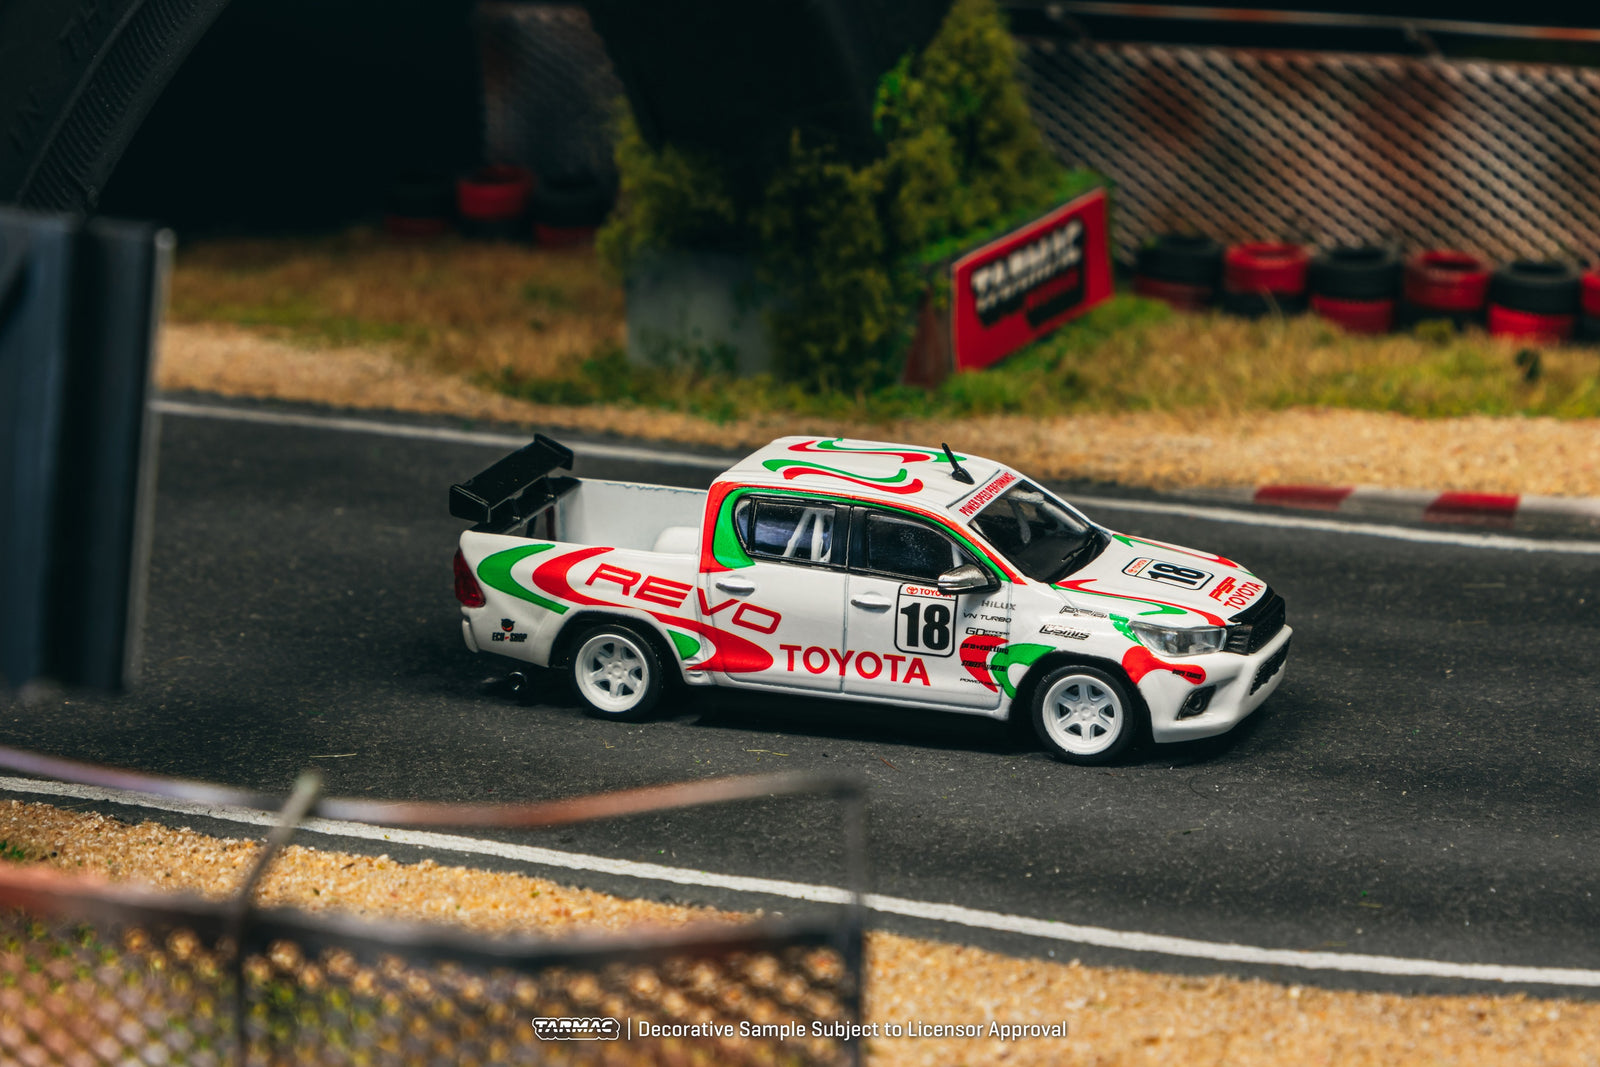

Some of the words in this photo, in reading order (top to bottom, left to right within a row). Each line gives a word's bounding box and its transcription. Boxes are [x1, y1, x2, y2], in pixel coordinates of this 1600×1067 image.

[1147, 563, 1205, 586] 18
[585, 563, 782, 634] REVO
[981, 600, 1016, 611] HILUX
[1223, 581, 1264, 610] TOYOTA
[900, 602, 950, 650] 18
[980, 614, 1012, 623] TURBO
[779, 644, 931, 686] TOYOTA
